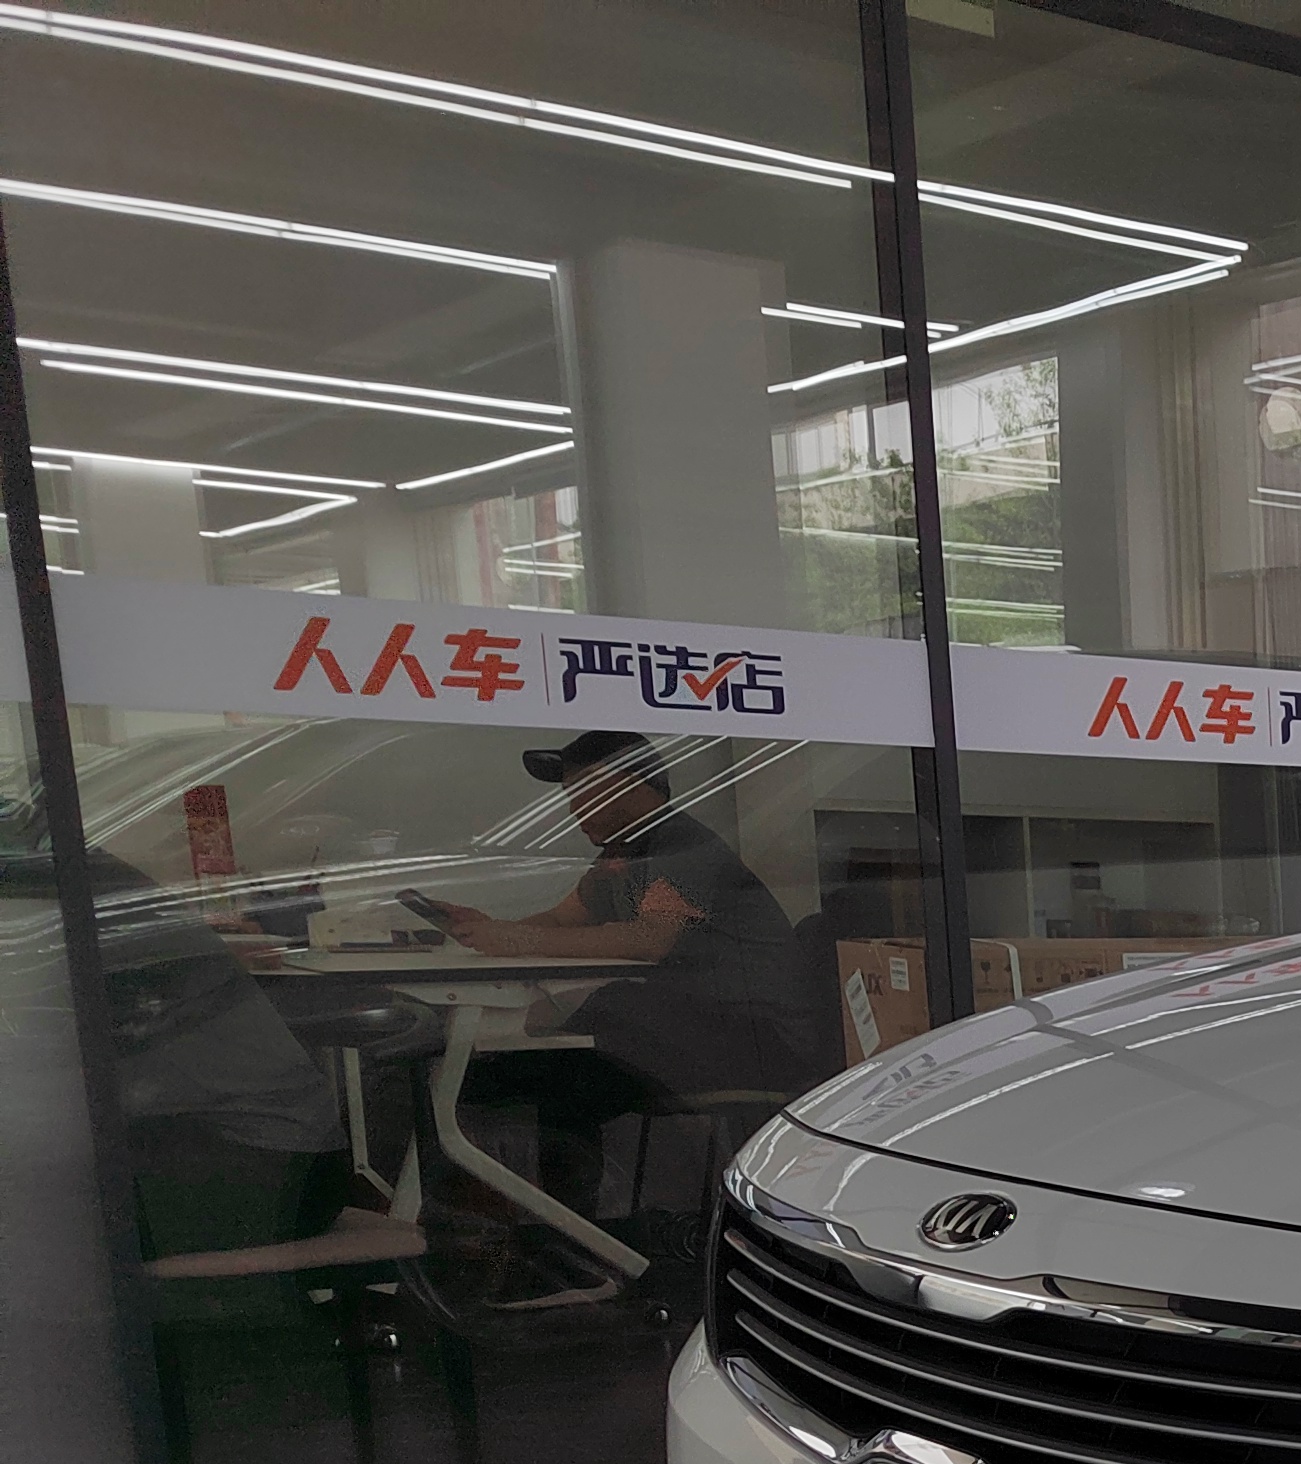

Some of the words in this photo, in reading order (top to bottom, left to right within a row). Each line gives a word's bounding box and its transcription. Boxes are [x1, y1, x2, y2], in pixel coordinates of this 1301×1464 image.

[273, 616, 526, 702] 人人车
[559, 637, 785, 715] 严选店
[1088, 676, 1255, 745] 人人车
